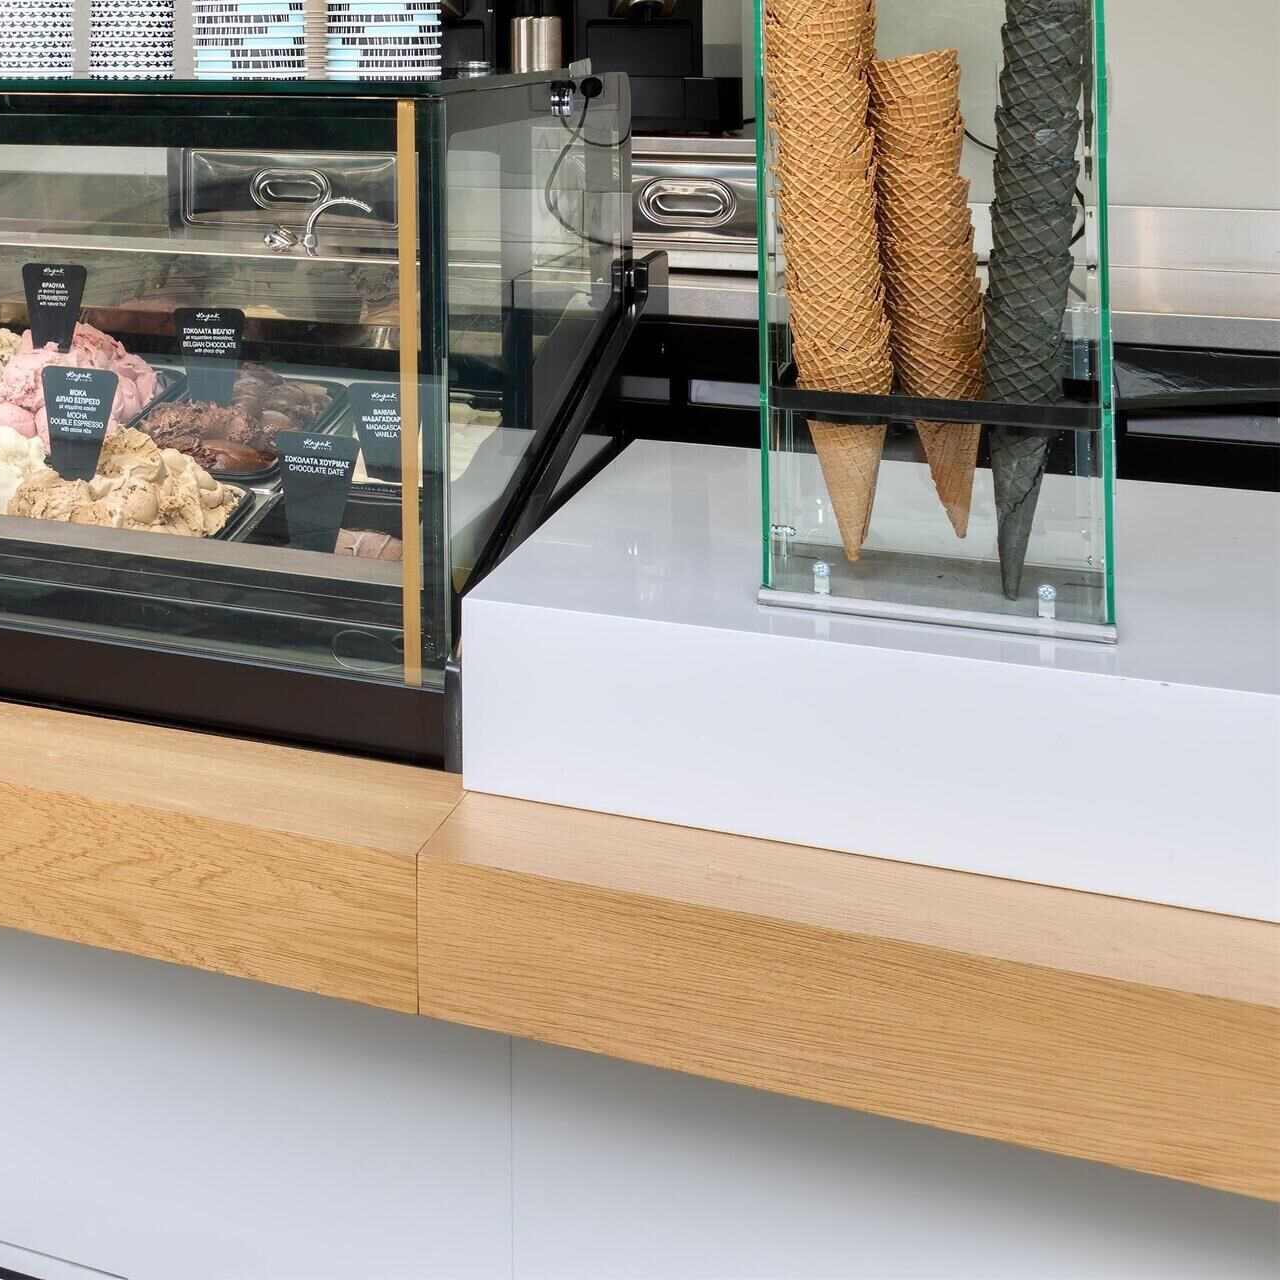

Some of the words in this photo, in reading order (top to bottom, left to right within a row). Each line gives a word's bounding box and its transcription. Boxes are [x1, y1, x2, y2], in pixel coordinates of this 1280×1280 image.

[205, 341, 237, 349] CHOCOLATE
[50, 417, 73, 426] DOUBLE
[73, 419, 104, 429] ESPRESSO
[365, 423, 401, 431] MADAGASCA
[288, 464, 327, 475] CHOCOLATE
[327, 467, 345, 477] DATE
